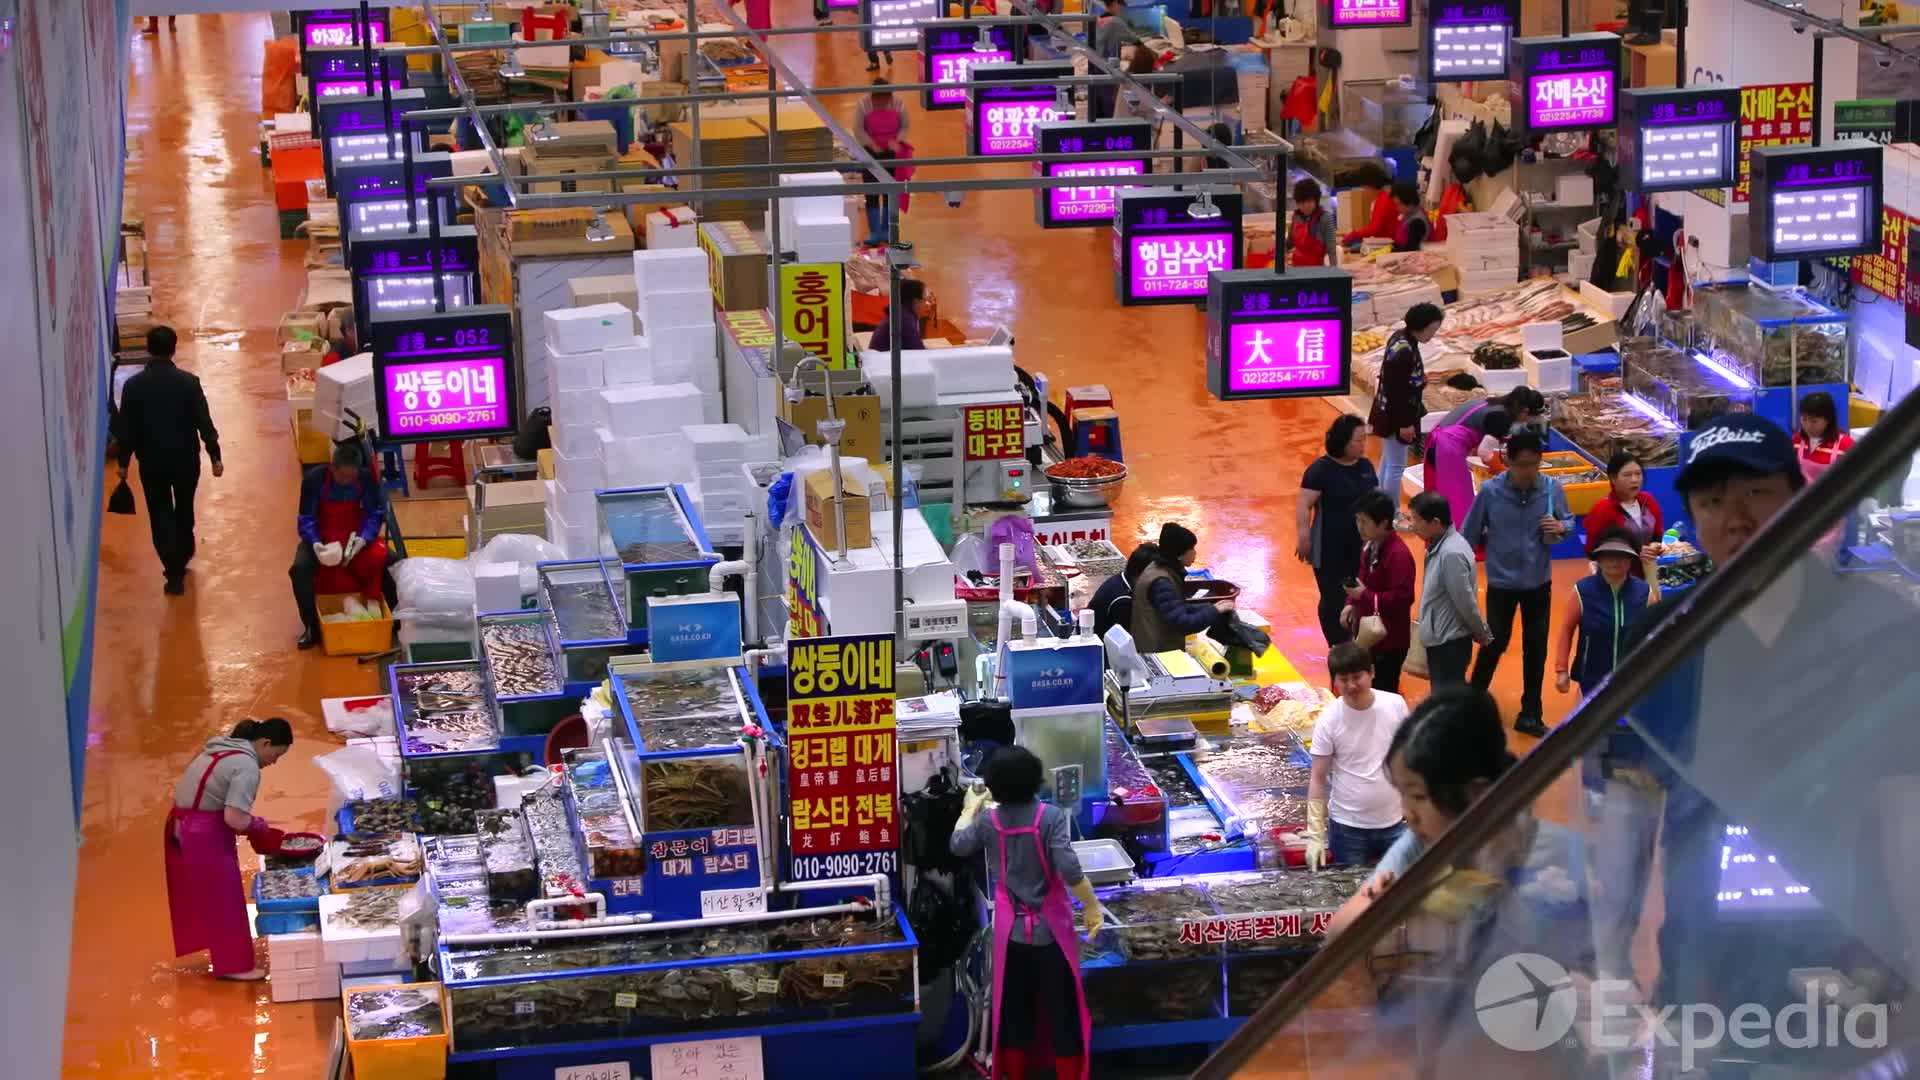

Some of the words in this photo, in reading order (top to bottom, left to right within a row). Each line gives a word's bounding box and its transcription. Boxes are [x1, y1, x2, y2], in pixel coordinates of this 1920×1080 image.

[1536, 75, 1608, 109] 자매수산
[1138, 239, 1226, 277] 형남수산
[454, 328, 490, 346] 052
[394, 365, 497, 410] 쌍둥이네
[399, 409, 497, 428] 010-9090-2761
[967, 407, 1023, 431] 동태포
[967, 432, 1023, 458] 대구포
[790, 639, 893, 694] 쌍둥이네
[791, 735, 849, 770] 킹크랩
[854, 733, 892, 765] 대게
[792, 796, 850, 831] 랍스타
[855, 793, 893, 825] 전복
[651, 837, 709, 859] 참문어
[662, 859, 693, 877] 대게
[793, 850, 898, 880] 010-9090-2761
[1178, 914, 1301, 945] 서산活꽃게
